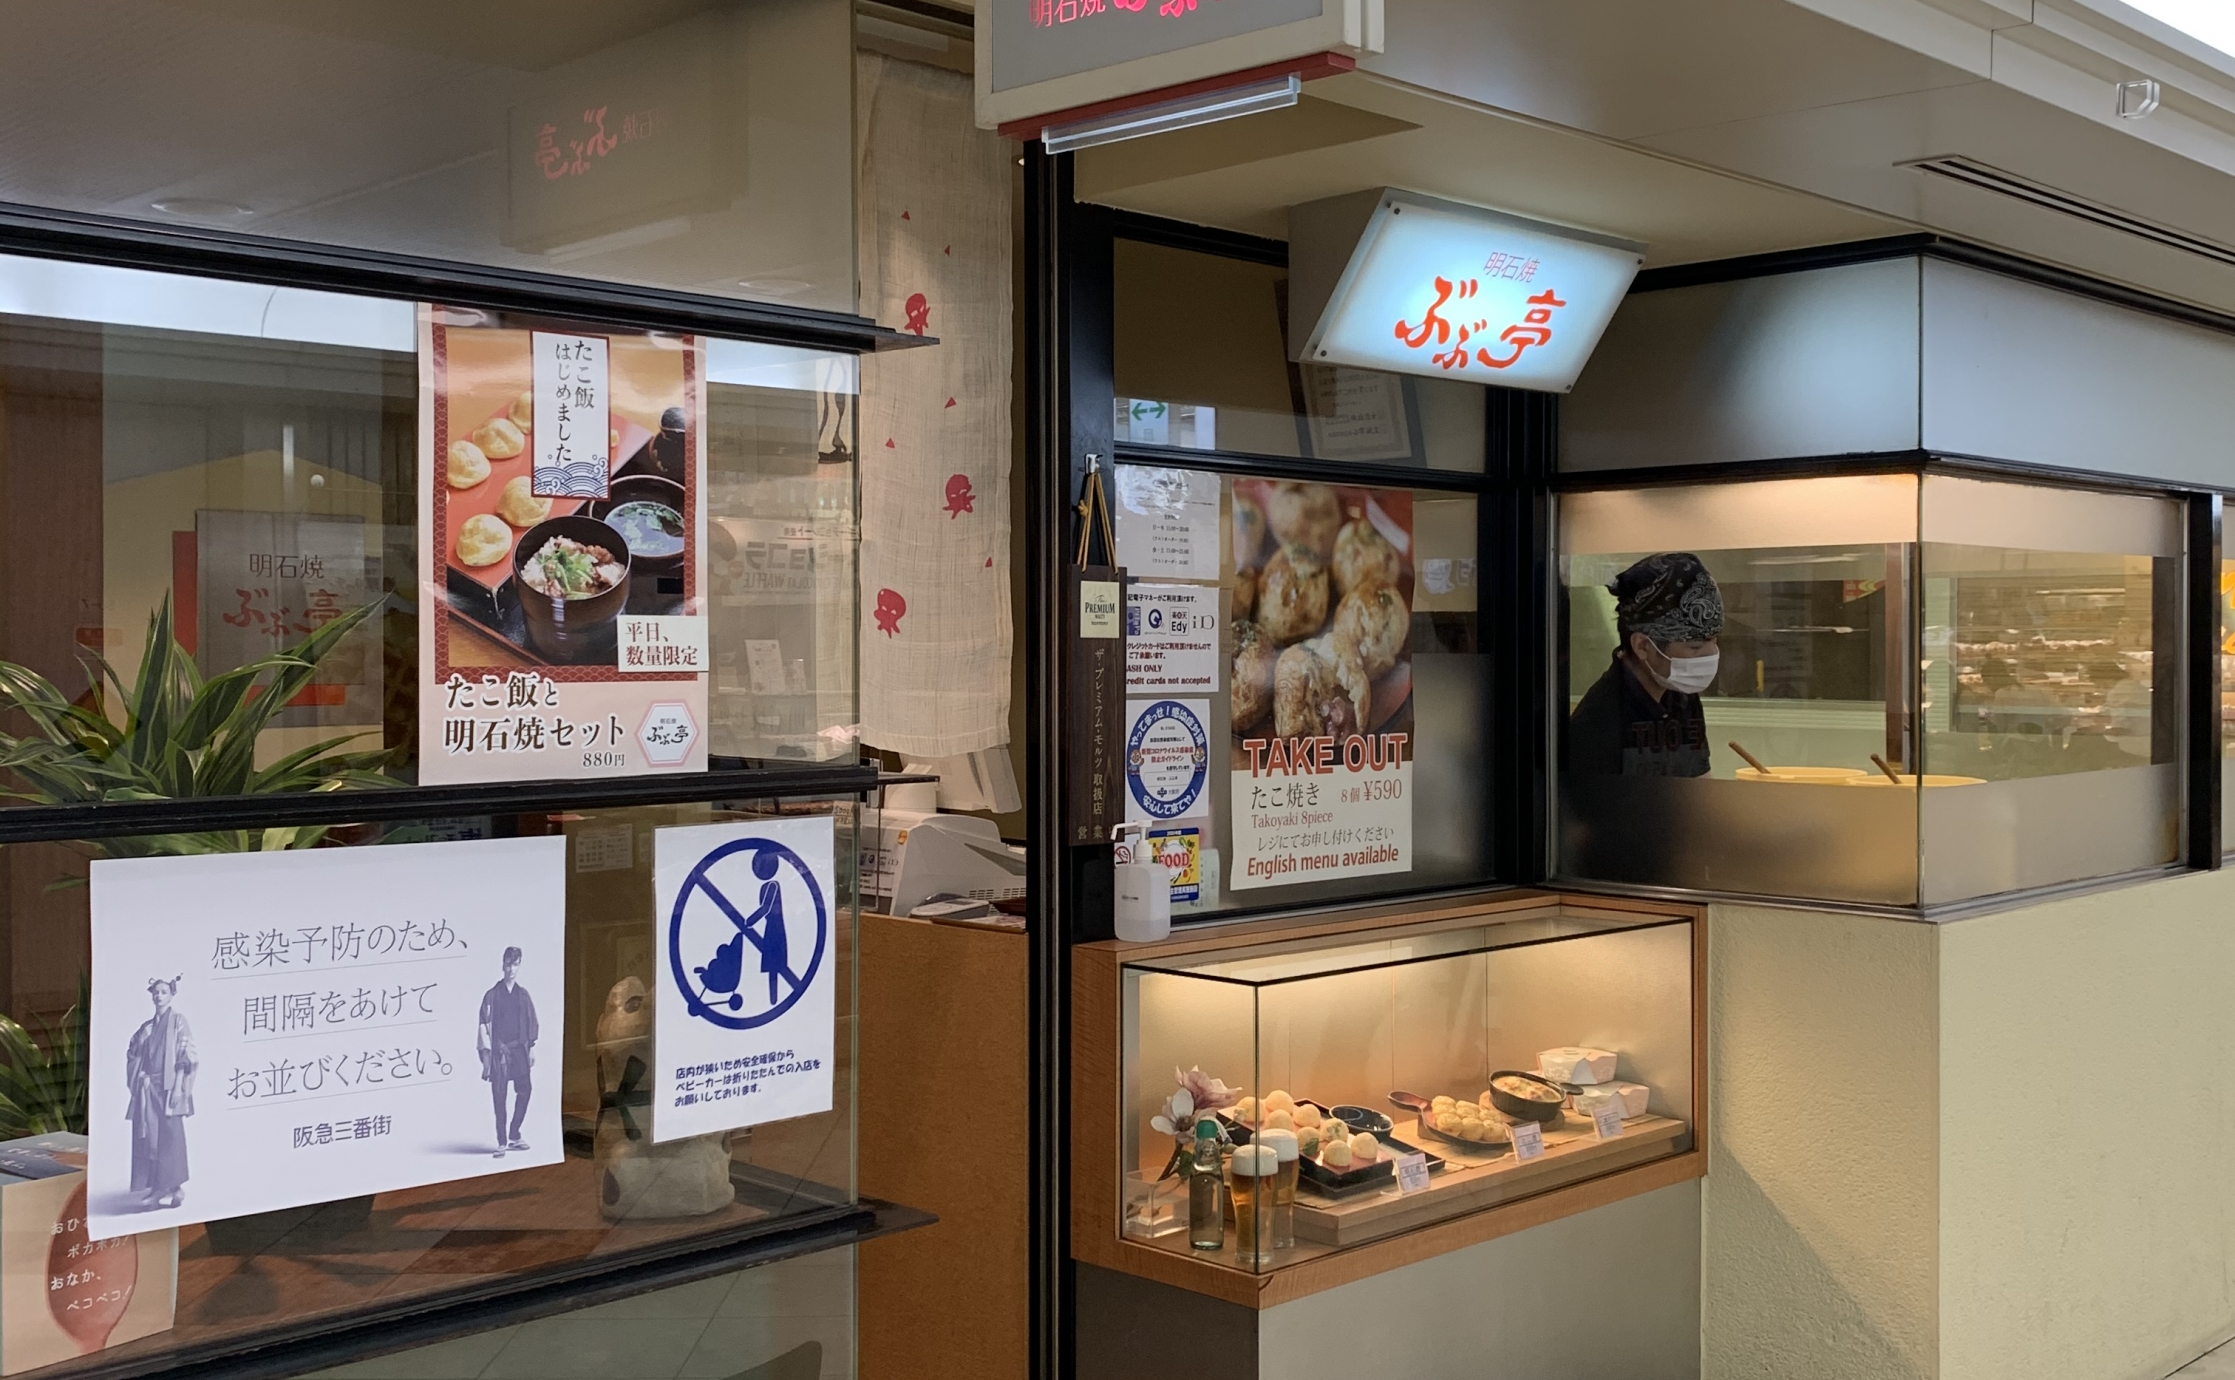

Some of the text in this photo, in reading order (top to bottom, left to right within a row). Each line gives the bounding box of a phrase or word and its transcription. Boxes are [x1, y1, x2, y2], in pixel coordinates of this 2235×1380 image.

[1483, 251, 1541, 284] 明石焼
[1394, 275, 1567, 370] ぶぶ亭
[574, 340, 595, 409] たこ飯
[249, 553, 325, 579] 明石焼
[1084, 602, 1116, 614] PREMIUM
[625, 621, 670, 643] 平日、
[1171, 621, 1188, 634] Edy
[626, 645, 698, 667] 数量限定
[1126, 664, 1163, 673] ASH ONLY
[447, 675, 558, 709] たこ飯と
[1126, 675, 1211, 686] redit cards not accepted
[444, 715, 624, 754] 明石焼セット
[646, 724, 689, 746] ぶぶ亭
[582, 751, 625, 768] 880円
[1243, 732, 1408, 778] TAKE OUT
[1092, 773, 1104, 816] 取扱店
[1251, 782, 1320, 810] たこ焼き
[1363, 778, 1403, 801] ¥590
[1077, 825, 1116, 840] 営業
[1251, 810, 1334, 831] Takoyaki 8piece
[1258, 826, 1394, 852] レジにてお申し付けください
[1247, 843, 1399, 880] English menu available
[210, 918, 469, 970] 感染予防のため、
[243, 982, 439, 1036] 間隔をあけて
[226, 1048, 453, 1100] お並びください。
[675, 1049, 795, 1080] 店内が狭いため安全確保から
[675, 1059, 822, 1092] ベビーカーは折りたたんでの入店を
[674, 1083, 762, 1108] お願いしております。
[292, 1114, 392, 1149] 阪急三番街
[51, 1269, 102, 1291] おなか、
